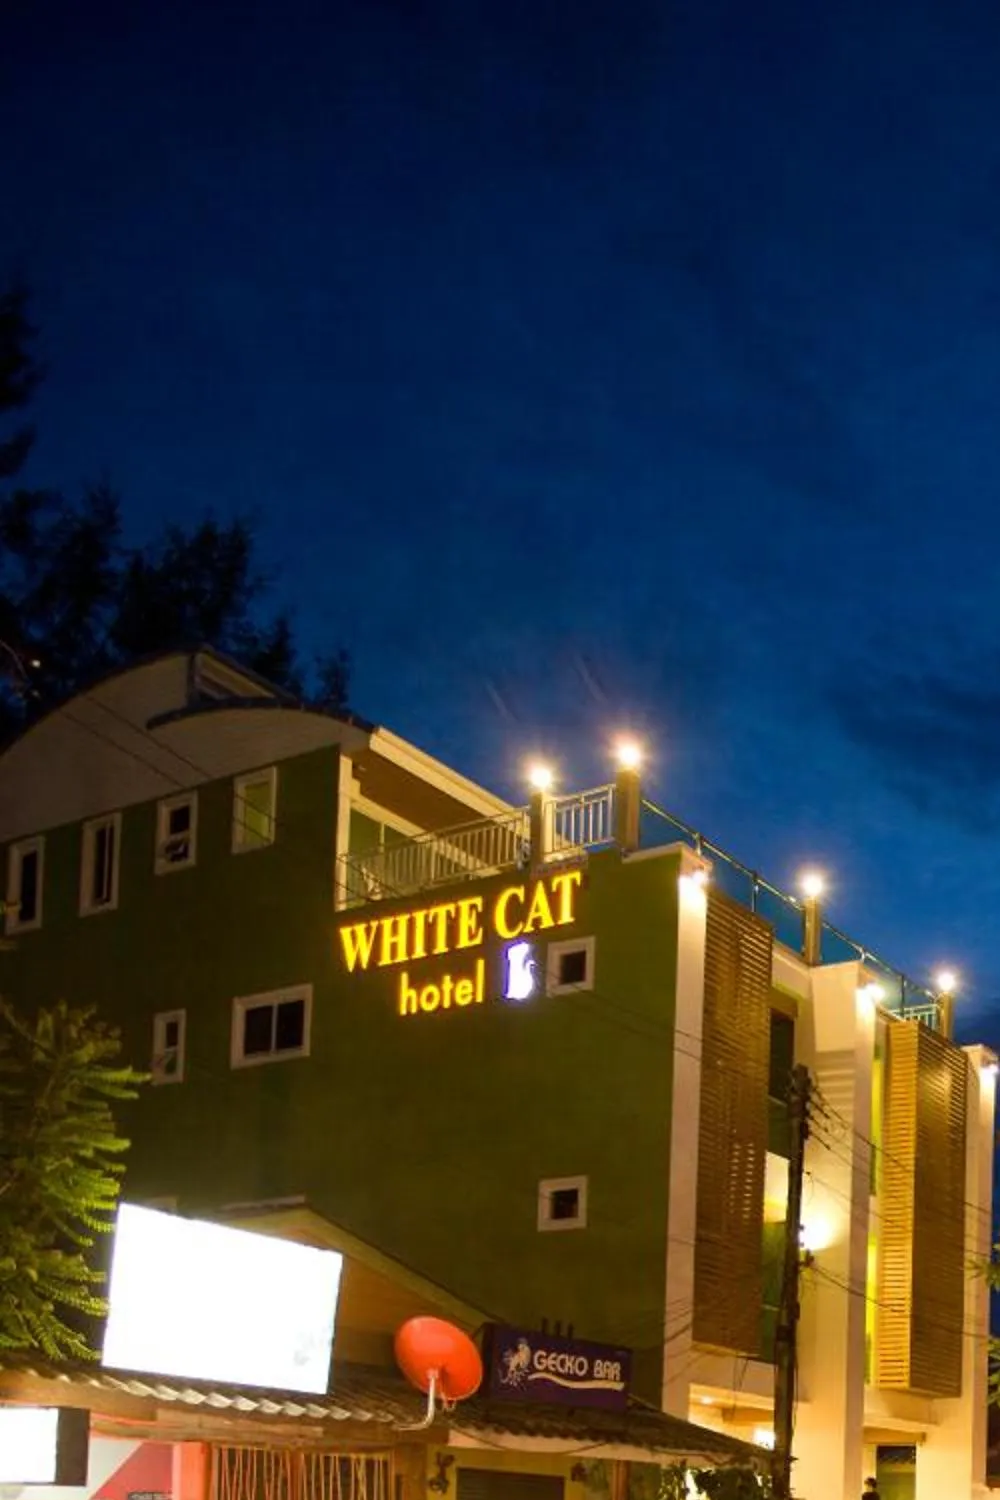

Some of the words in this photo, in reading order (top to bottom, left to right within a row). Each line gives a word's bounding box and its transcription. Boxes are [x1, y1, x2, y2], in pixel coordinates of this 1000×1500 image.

[339, 896, 483, 973] WHITE
[494, 871, 582, 939] CAT
[399, 958, 485, 1016] hotel
[533, 1350, 588, 1377] GECKO
[593, 1359, 621, 1381] BAR
